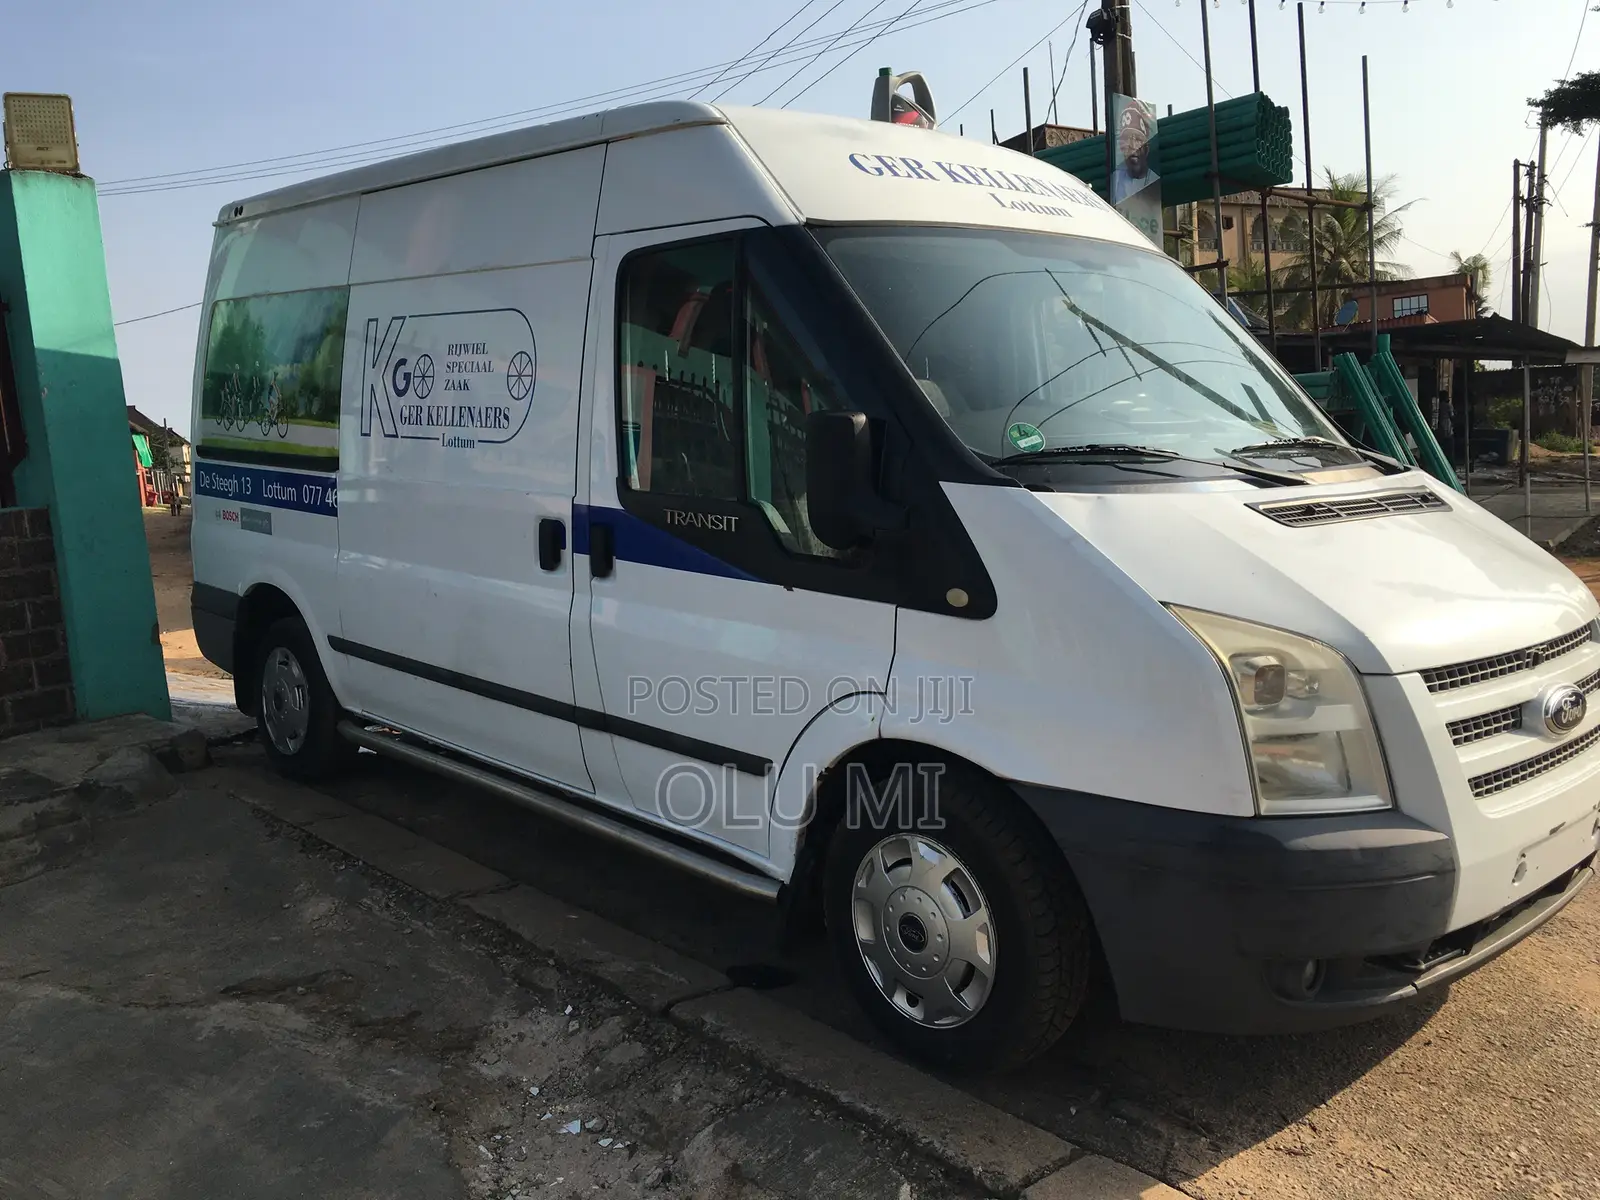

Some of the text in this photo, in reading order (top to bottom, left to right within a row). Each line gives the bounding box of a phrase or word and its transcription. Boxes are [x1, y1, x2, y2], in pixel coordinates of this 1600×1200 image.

[848, 152, 940, 182] GER
[988, 192, 1073, 218] Lottum
[447, 342, 489, 356] RIJWIEL
[445, 360, 494, 374] SPECIAAL
[443, 378, 470, 392] ZAAK
[400, 404, 510, 430] GER KELLENAERS
[441, 433, 475, 449] Lottum
[200, 470, 211, 489] De
[211, 472, 239, 497] Steegh
[241, 476, 252, 495] 13
[262, 479, 297, 502] Lottum
[302, 484, 322, 506] 077
[222, 509, 239, 523] BOSCH
[663, 508, 739, 532] TRANSIT
